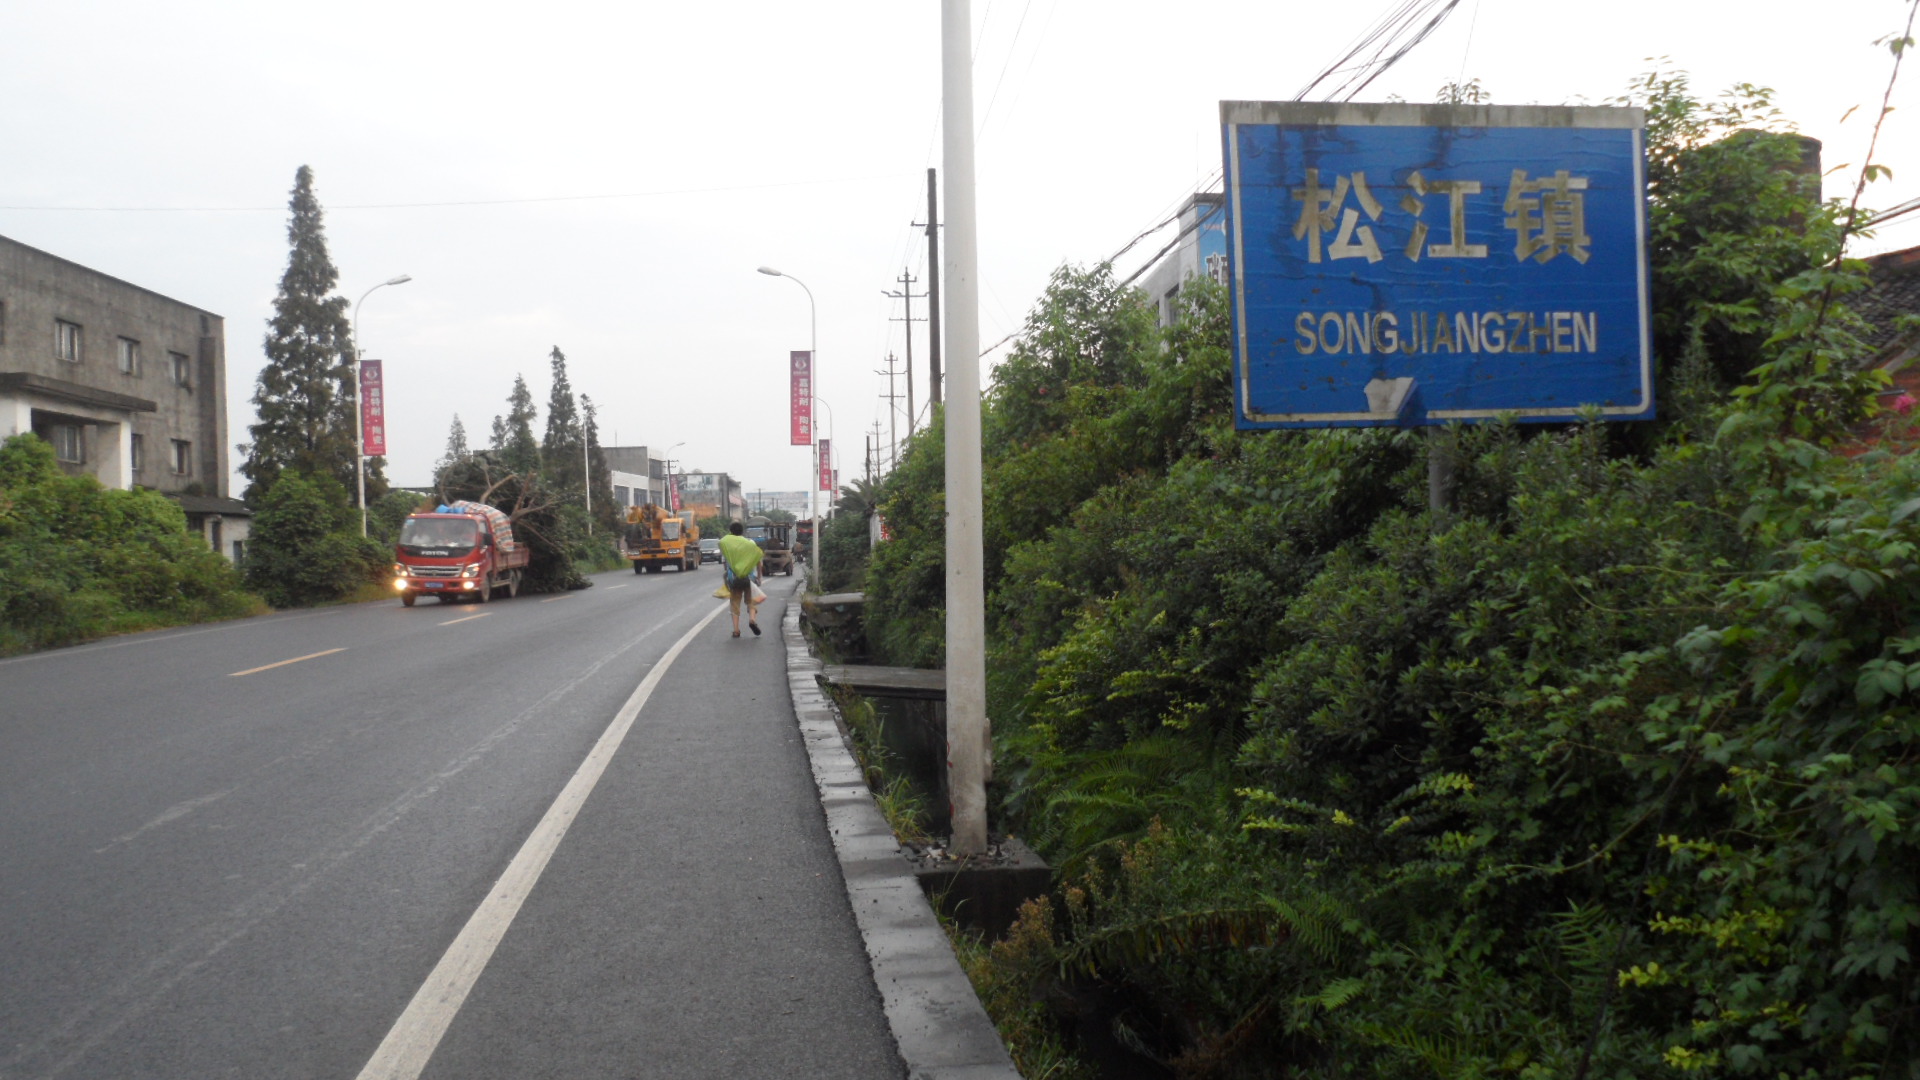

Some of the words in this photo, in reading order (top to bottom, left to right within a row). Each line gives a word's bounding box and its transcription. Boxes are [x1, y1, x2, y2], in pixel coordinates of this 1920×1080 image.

[1292, 168, 1592, 265] 松江镇
[1294, 311, 1597, 355] SONGJIANGZHEN
